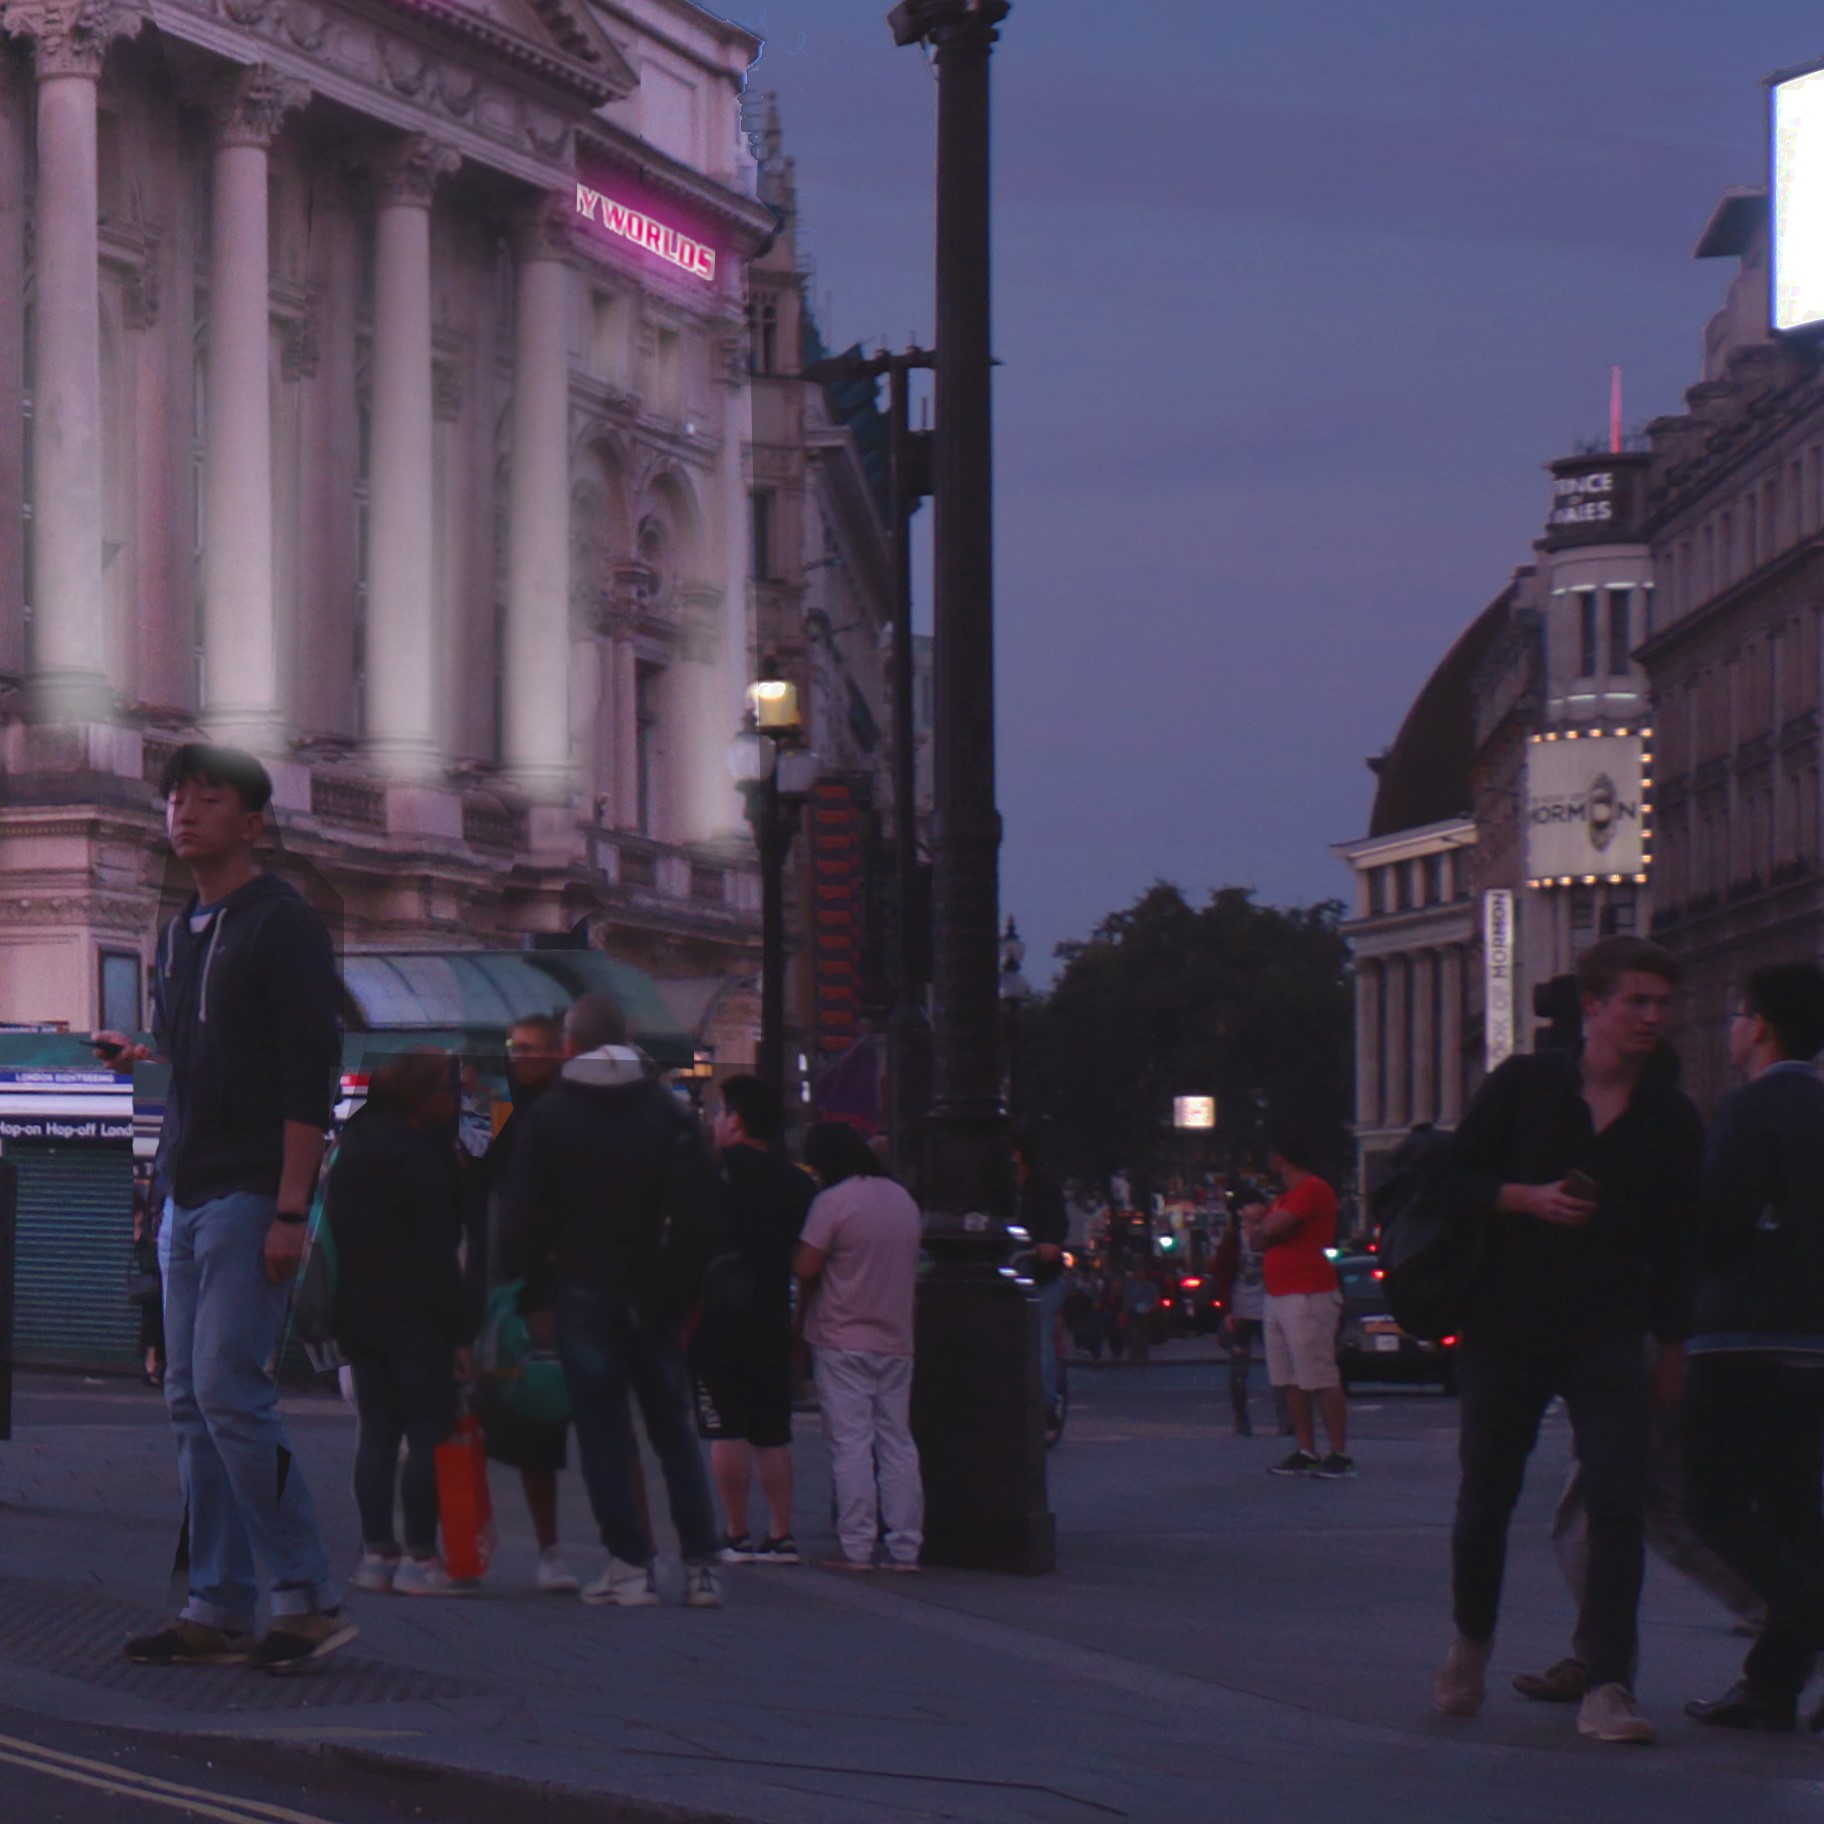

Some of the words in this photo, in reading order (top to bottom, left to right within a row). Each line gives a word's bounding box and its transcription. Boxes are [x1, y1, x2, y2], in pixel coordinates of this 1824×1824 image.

[602, 195, 715, 281] WORLDS
[46, 1121, 96, 1137] Hop-off
[101, 1123, 133, 1137] Lond
